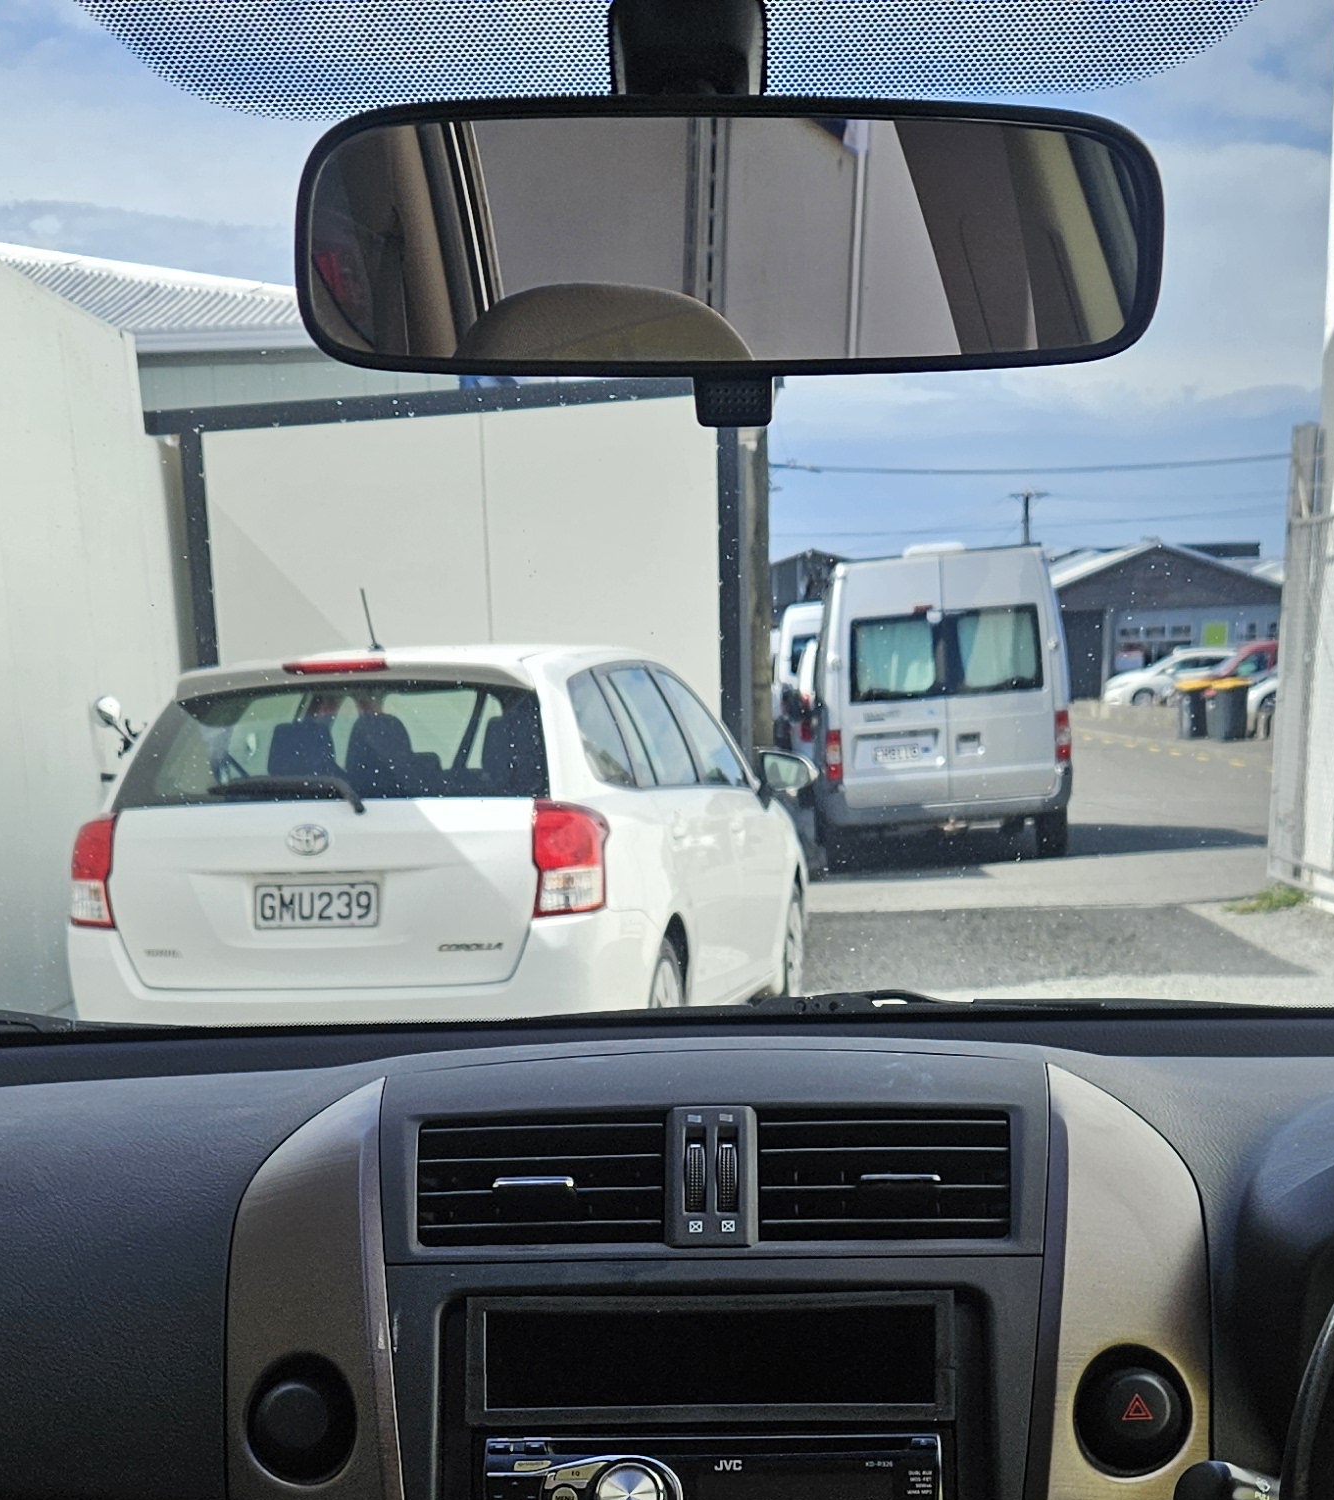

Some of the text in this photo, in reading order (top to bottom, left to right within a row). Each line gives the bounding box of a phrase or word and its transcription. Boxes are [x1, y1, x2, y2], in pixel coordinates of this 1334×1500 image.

[259, 890, 373, 923] GMU239
[437, 942, 503, 952] COROLLA
[714, 1459, 743, 1472] JVC
